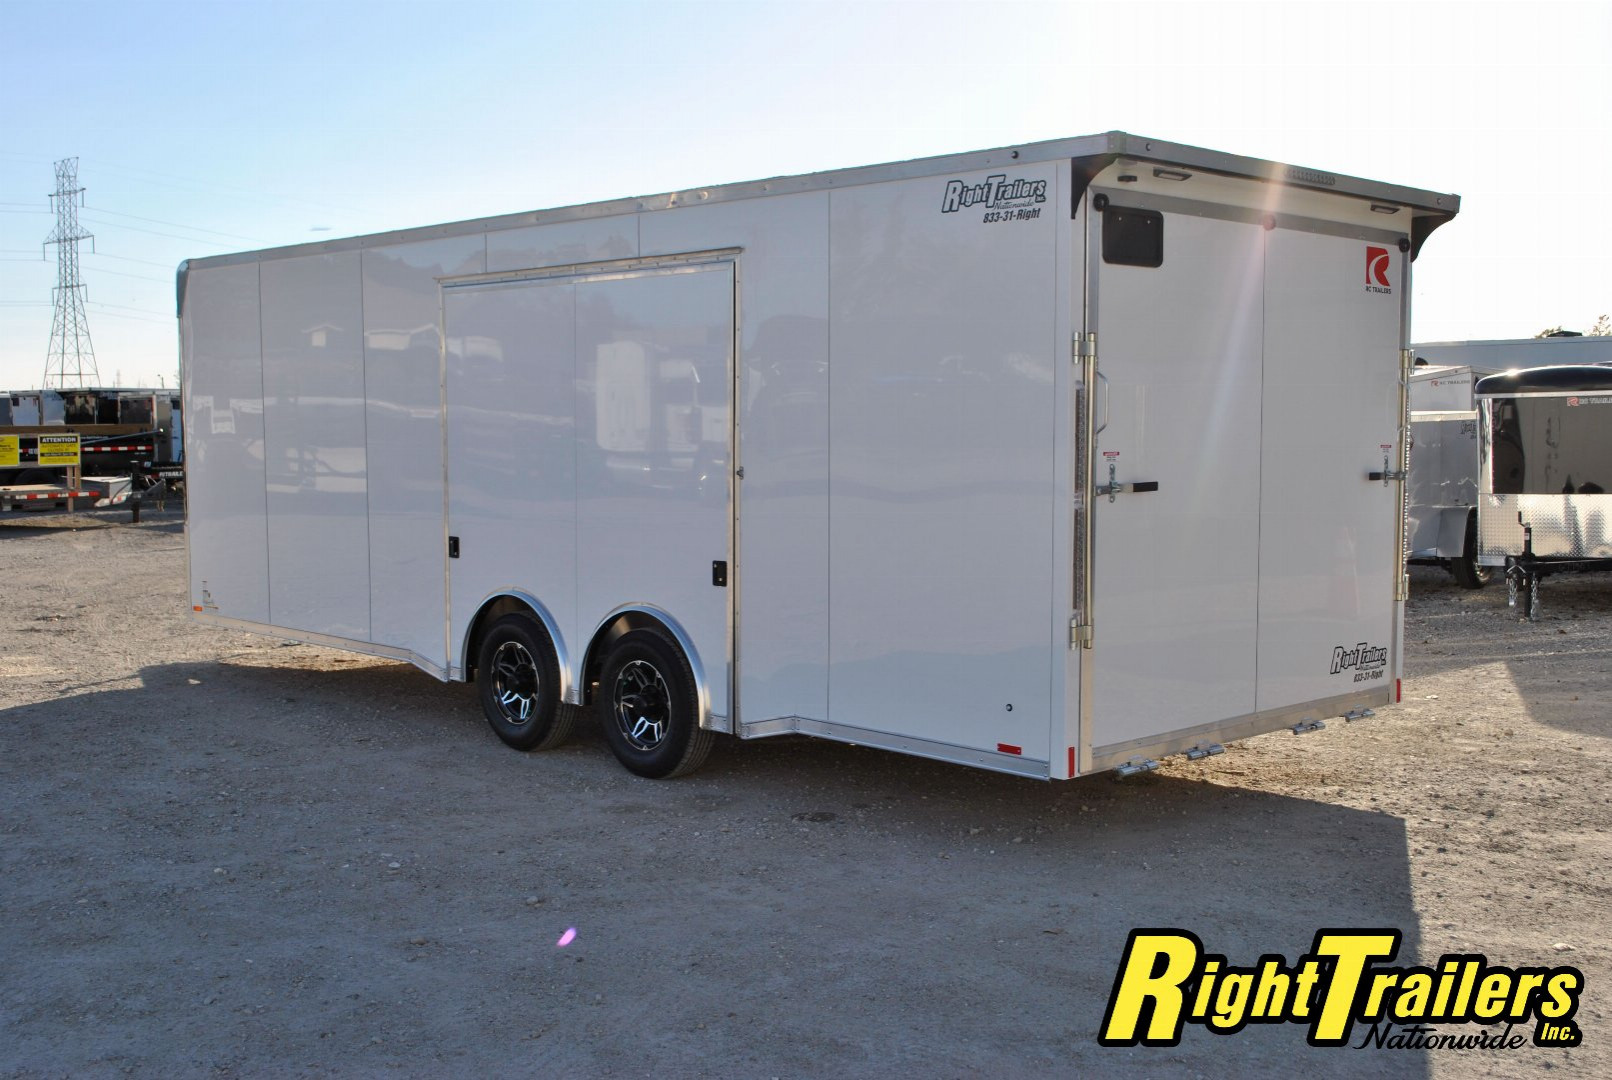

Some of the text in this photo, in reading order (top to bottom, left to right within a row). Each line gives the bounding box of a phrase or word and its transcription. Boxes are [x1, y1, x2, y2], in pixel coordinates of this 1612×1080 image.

[994, 201, 1035, 210] Nationwide
[983, 208, 1041, 223] 833-31-Right
[1372, 286, 1391, 294] TRAILERS
[1353, 669, 1383, 682] 833-31-Right
